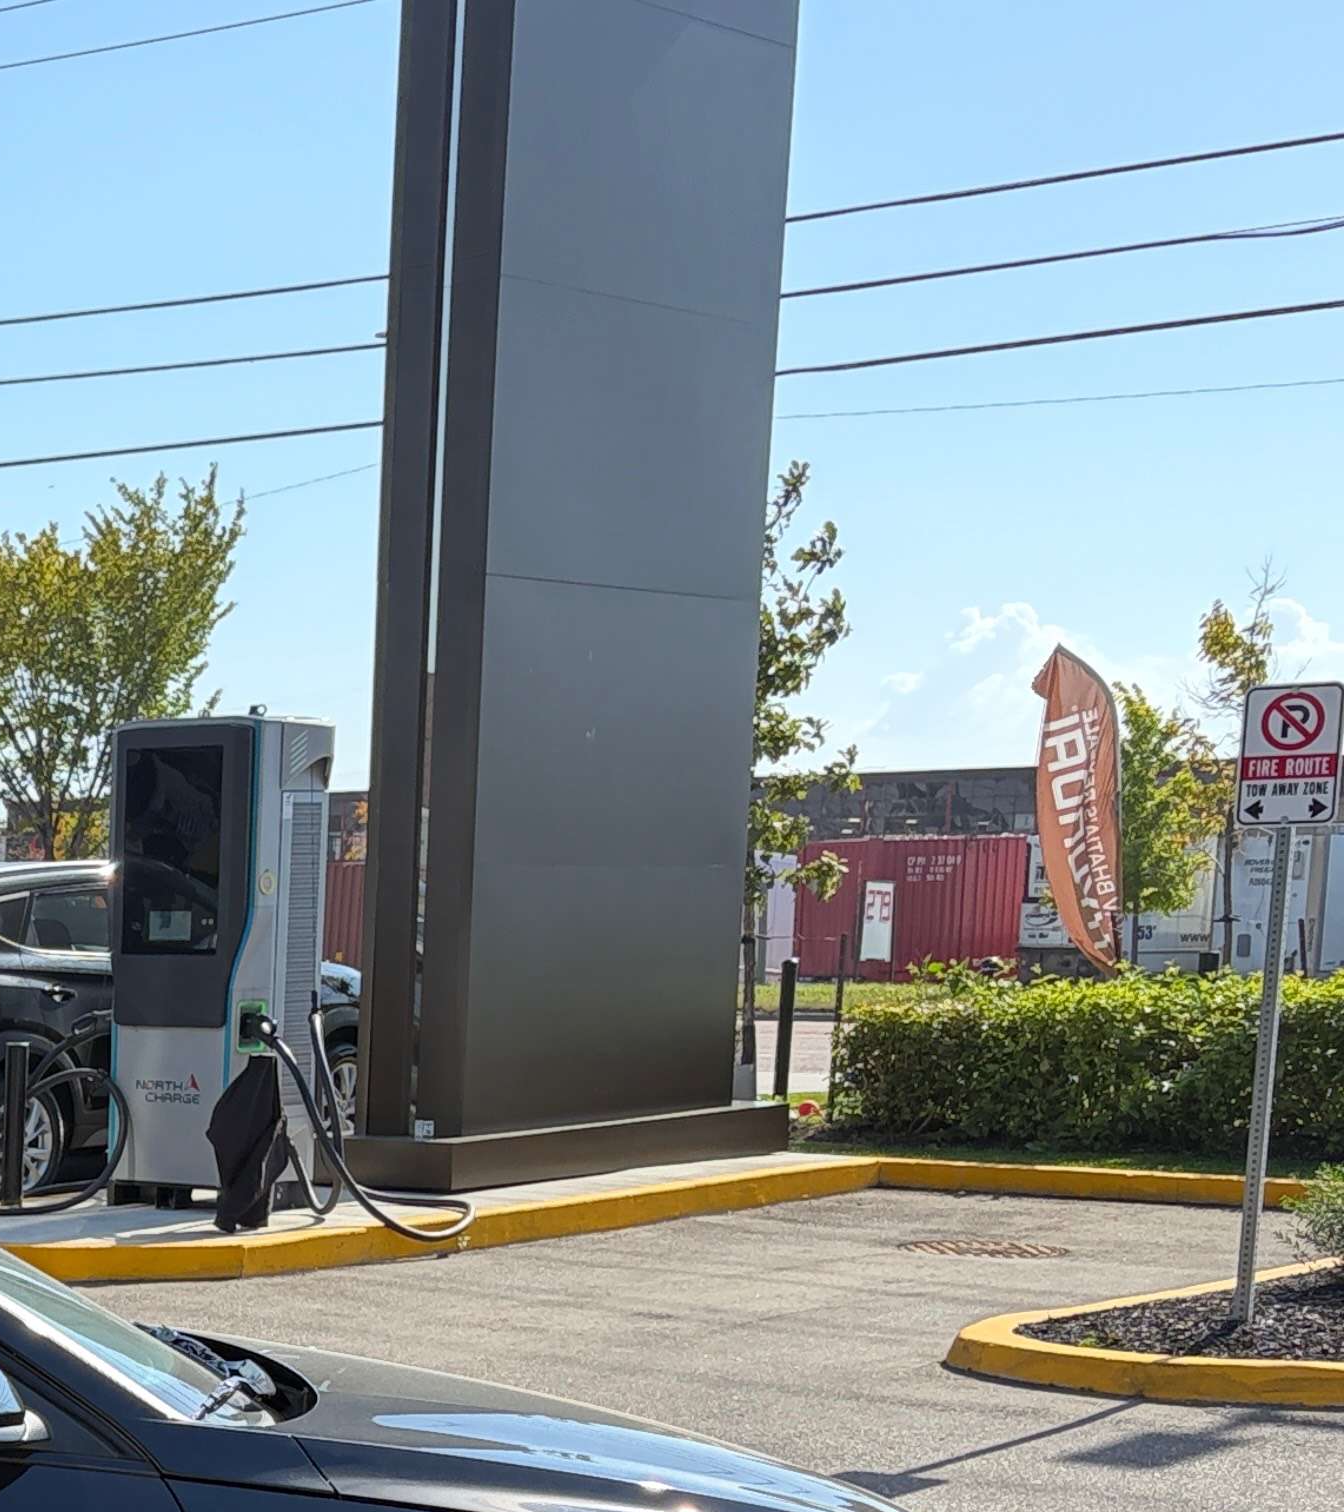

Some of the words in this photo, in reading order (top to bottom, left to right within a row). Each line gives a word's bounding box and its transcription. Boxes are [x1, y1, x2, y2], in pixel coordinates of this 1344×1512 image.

[1247, 758, 1280, 778] FIRE
[1284, 756, 1331, 776] ROUTE
[1246, 783, 1268, 798] TOW
[1271, 781, 1301, 797] AWAY
[1302, 780, 1329, 796] ZONE
[135, 1079, 183, 1091] NORTH
[145, 1092, 201, 1105] CHARGE
